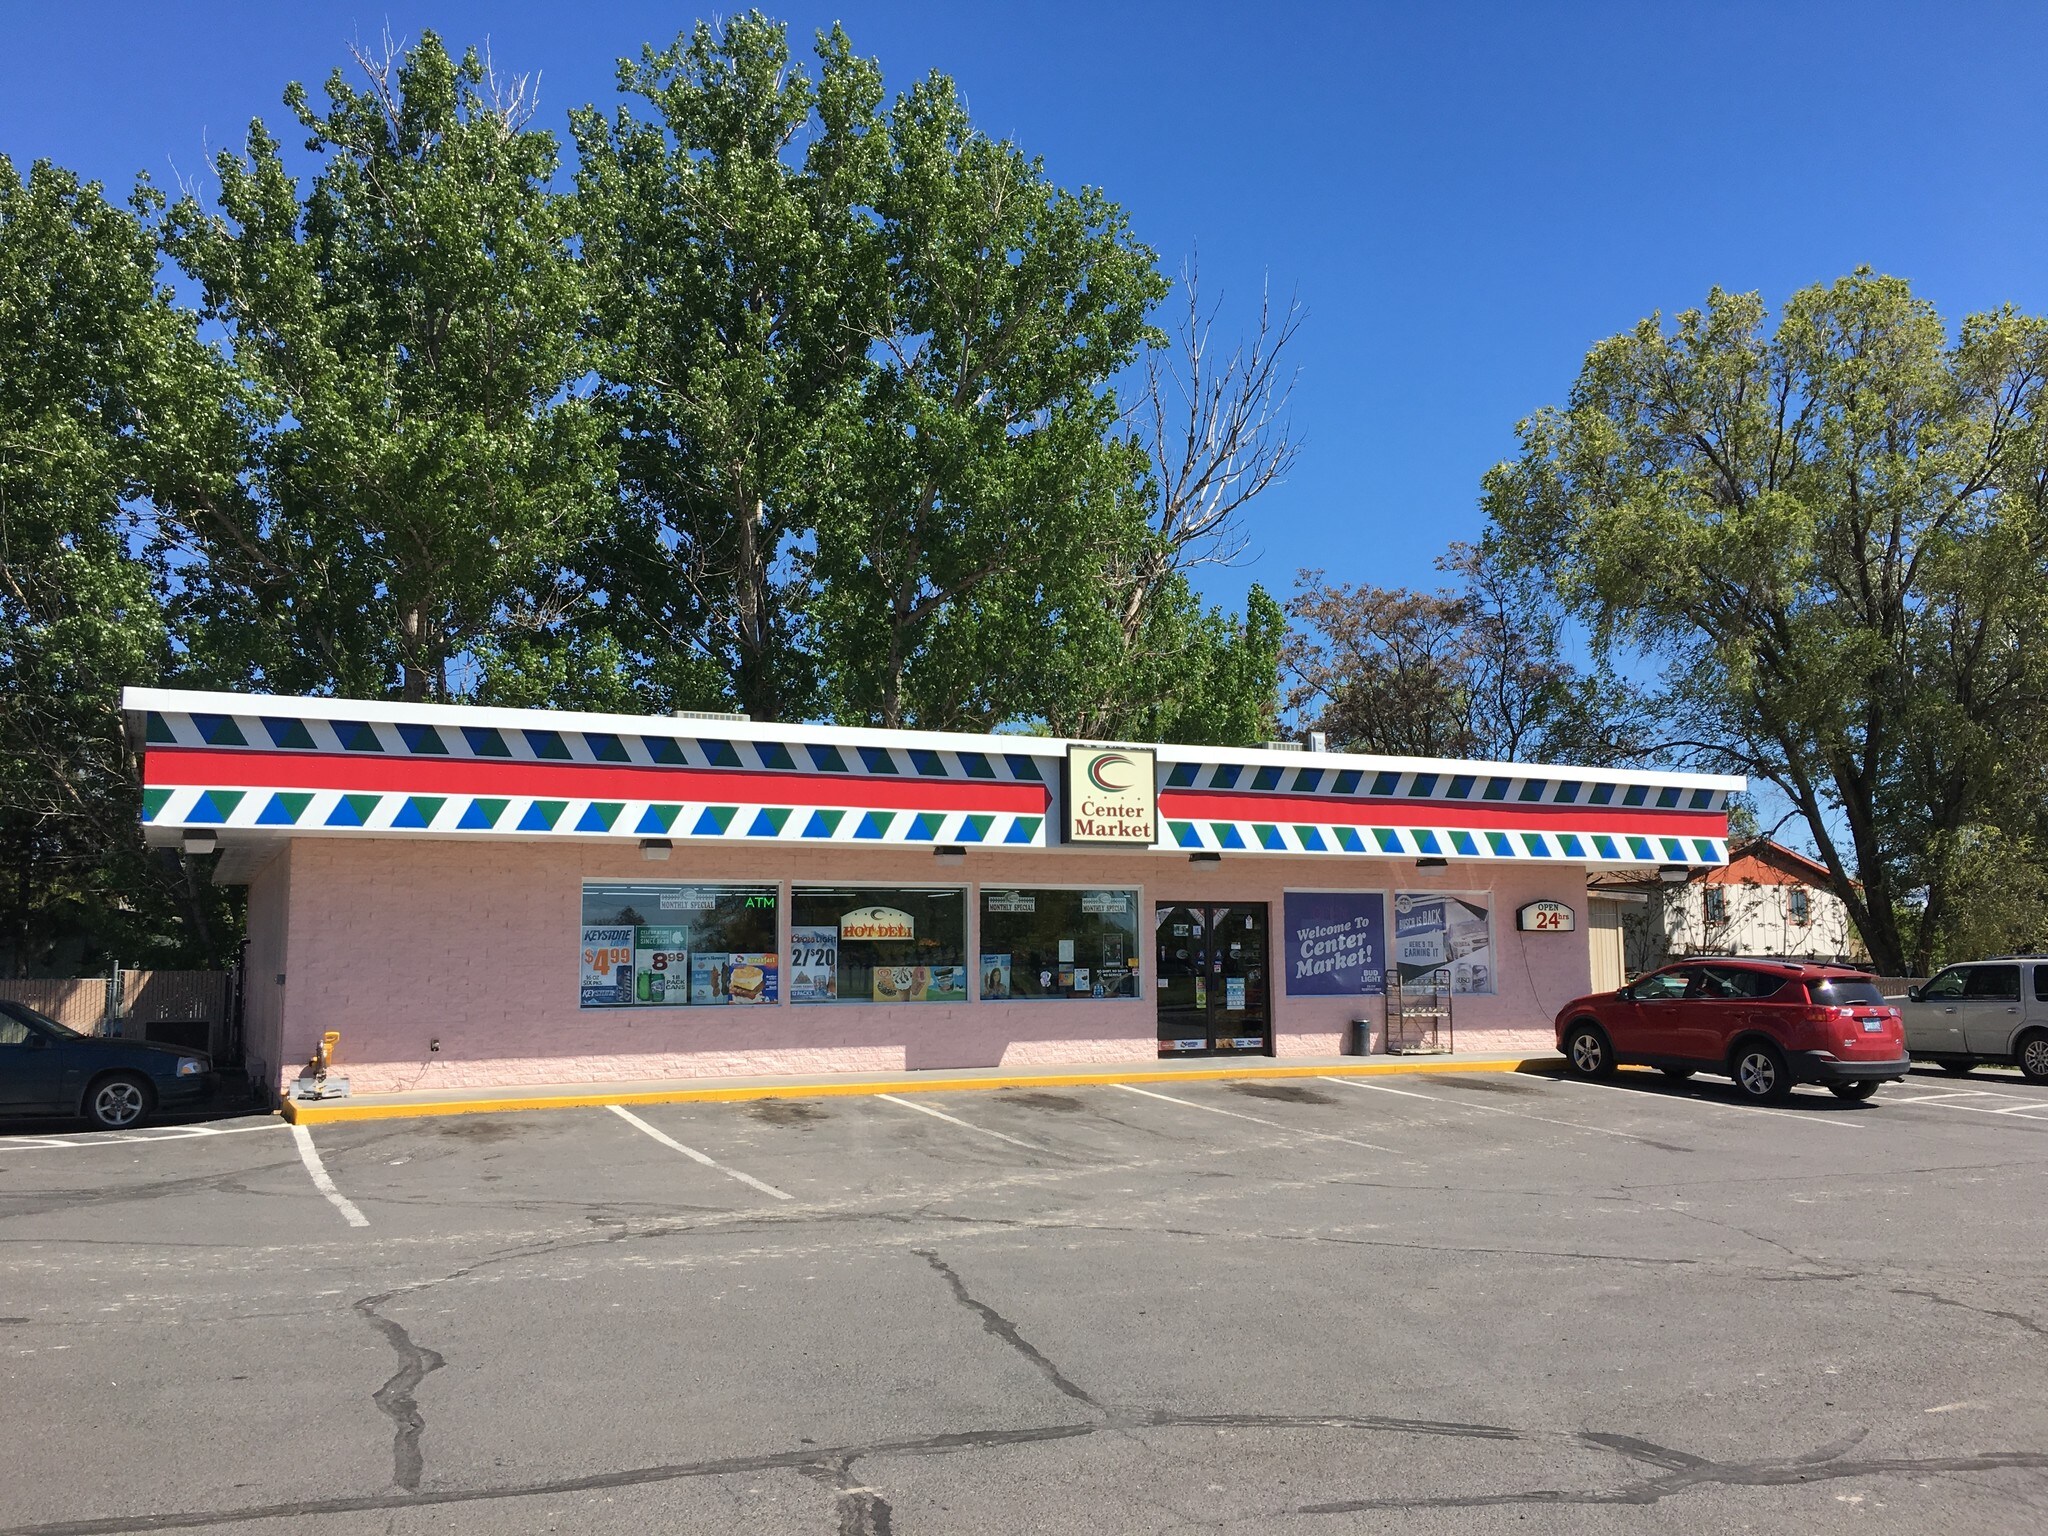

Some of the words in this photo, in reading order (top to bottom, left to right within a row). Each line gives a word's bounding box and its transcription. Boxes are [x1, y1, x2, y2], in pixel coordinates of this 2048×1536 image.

[1081, 801, 1144, 818] Center
[1074, 818, 1151, 838] Market
[661, 901, 687, 909] MONTHLY
[690, 901, 714, 909] SPECIAL
[745, 897, 775, 908] ATM
[989, 903, 1012, 911] MONTHLY
[1014, 903, 1034, 911] SPECIAL
[1083, 904, 1105, 912] MONTHLY
[1106, 904, 1126, 912] SPECIAL
[1537, 903, 1559, 911] OPEN
[843, 924, 874, 938] HOT
[877, 924, 913, 938] DELI
[1297, 921, 1351, 941] Welcome
[1354, 916, 1370, 929] To
[585, 930, 632, 941] KEYSTONE
[815, 935, 837, 943] LIGHT
[1300, 932, 1367, 959] Center
[1432, 948, 1439, 957] IT
[1295, 944, 1373, 979] Market!
[1361, 975, 1382, 983] LIGHT
